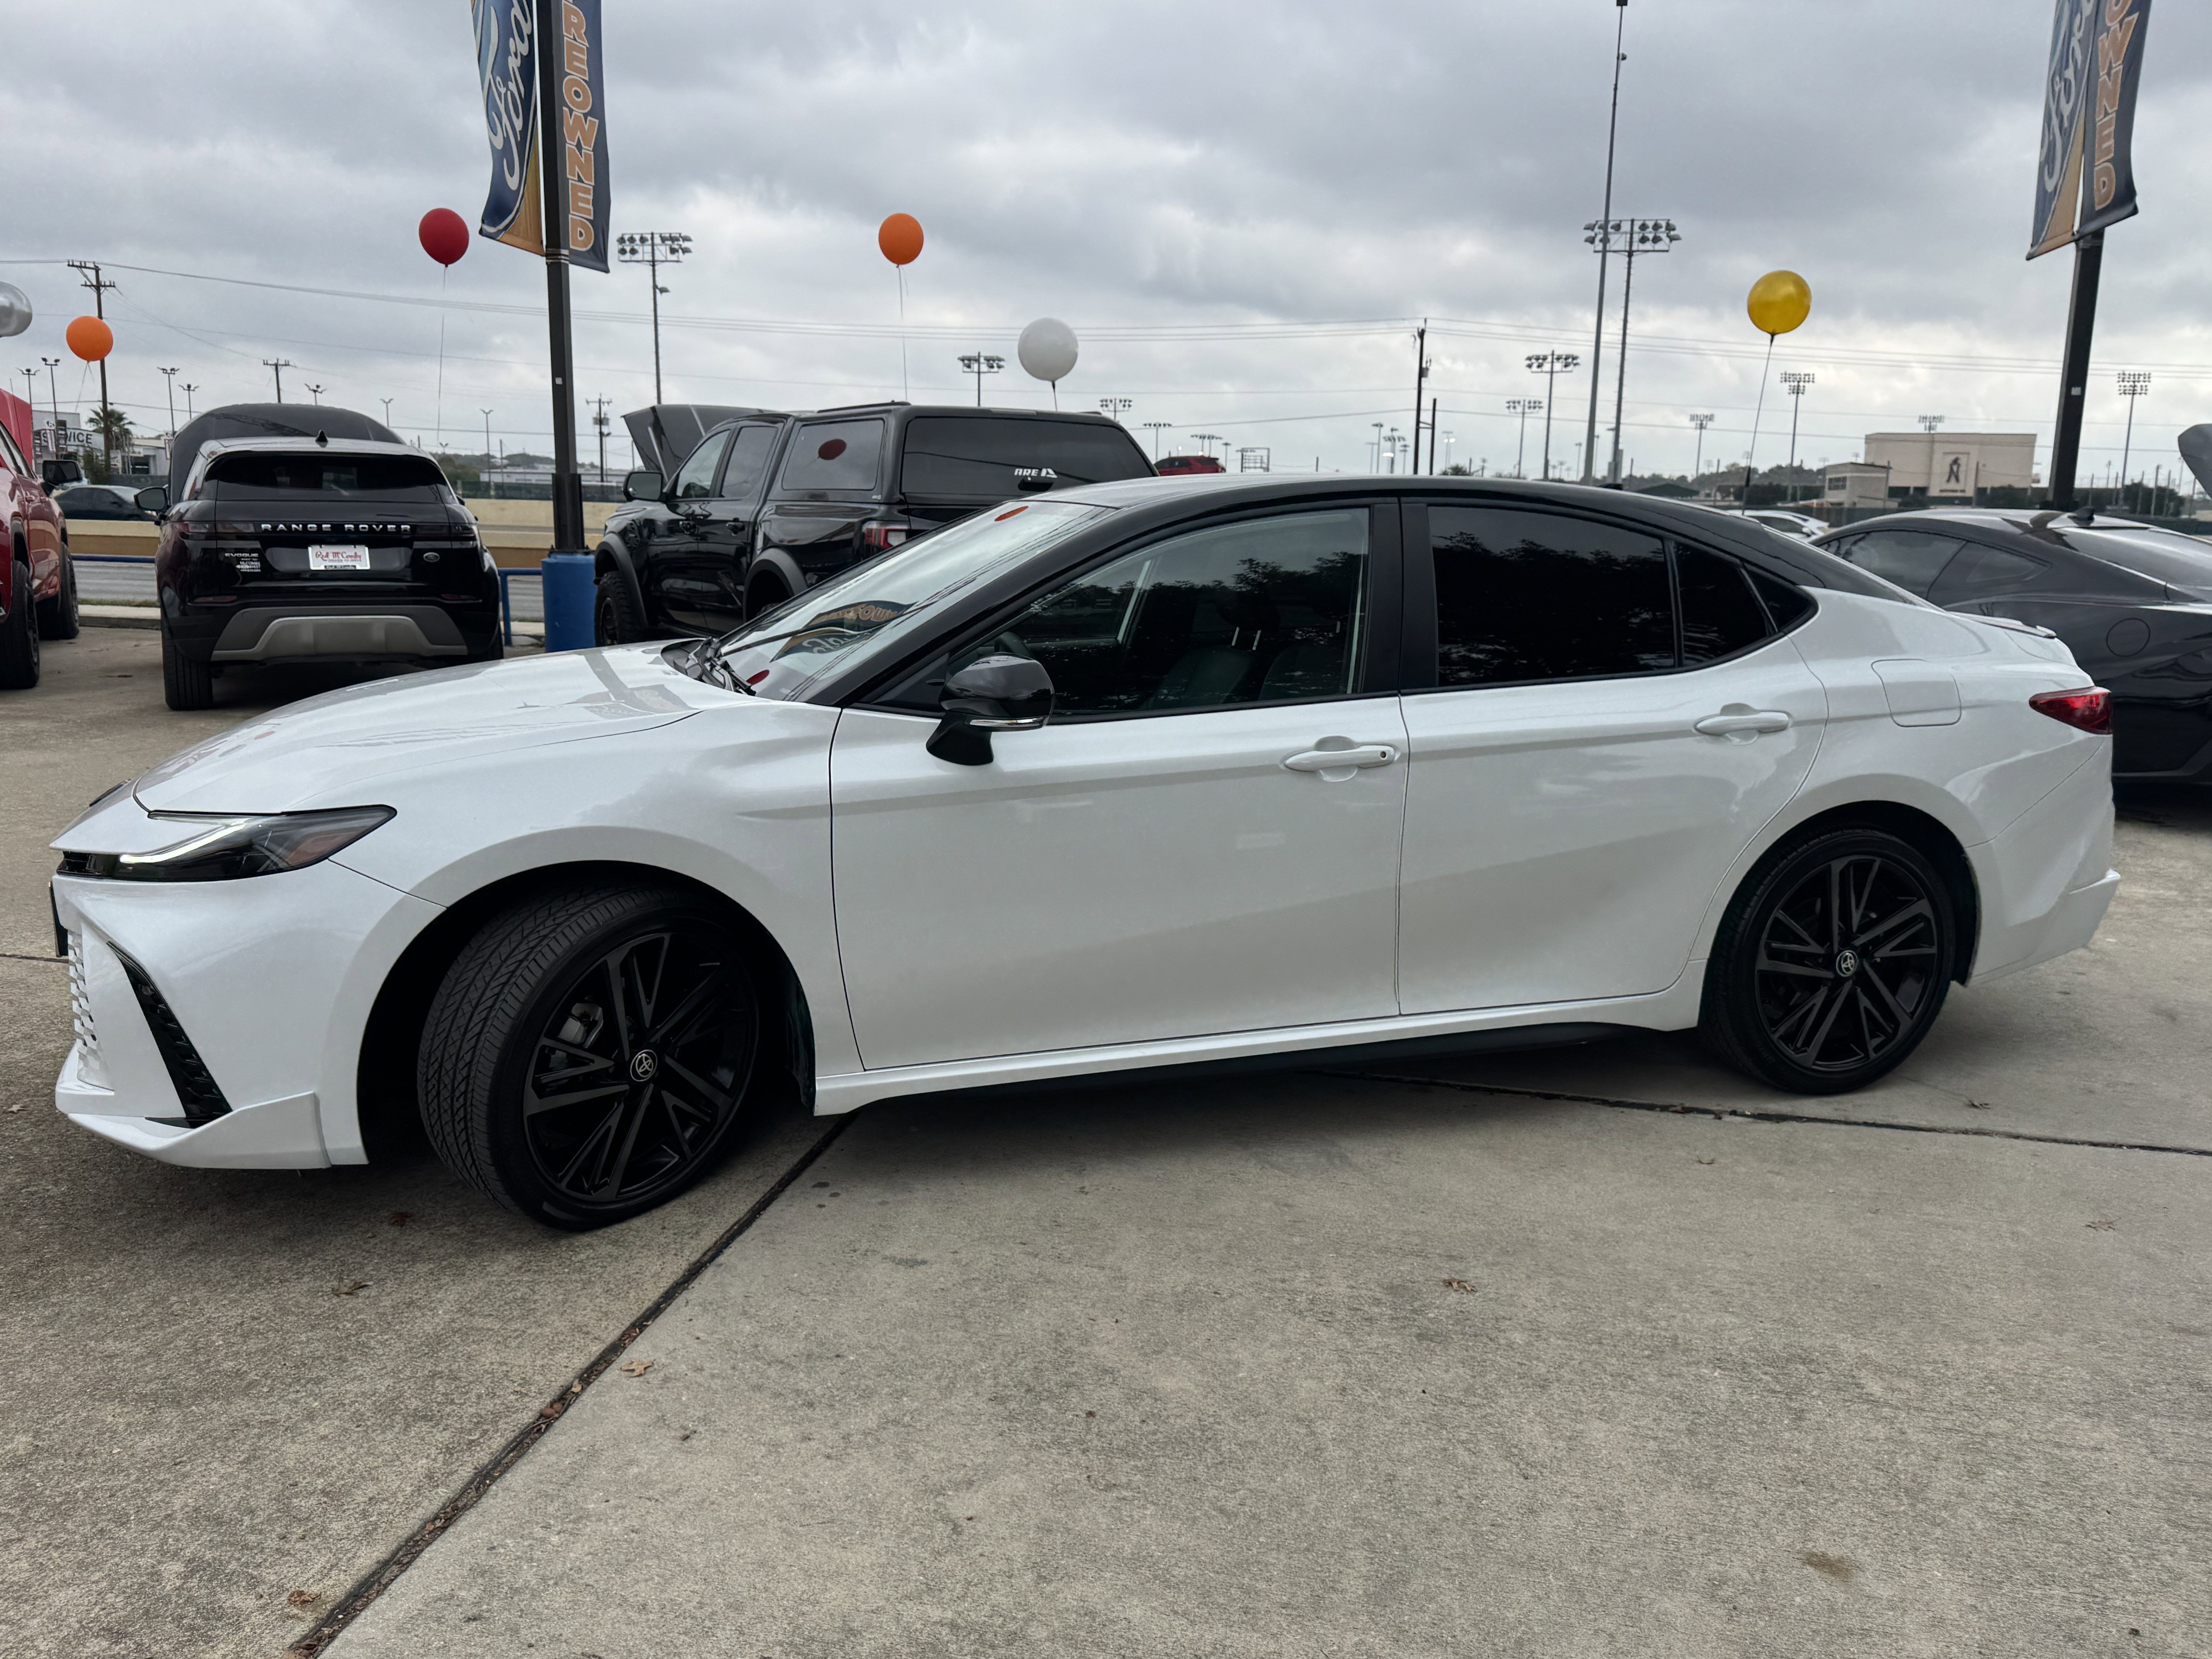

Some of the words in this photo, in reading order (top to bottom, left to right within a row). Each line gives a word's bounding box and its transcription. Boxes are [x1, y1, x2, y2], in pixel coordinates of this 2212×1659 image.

[483, 0, 532, 190] Ford
[562, 0, 599, 252] REOWNED
[1014, 468, 1039, 476] ARE
[261, 524, 332, 532] RANGE
[345, 524, 412, 532] ROVER
